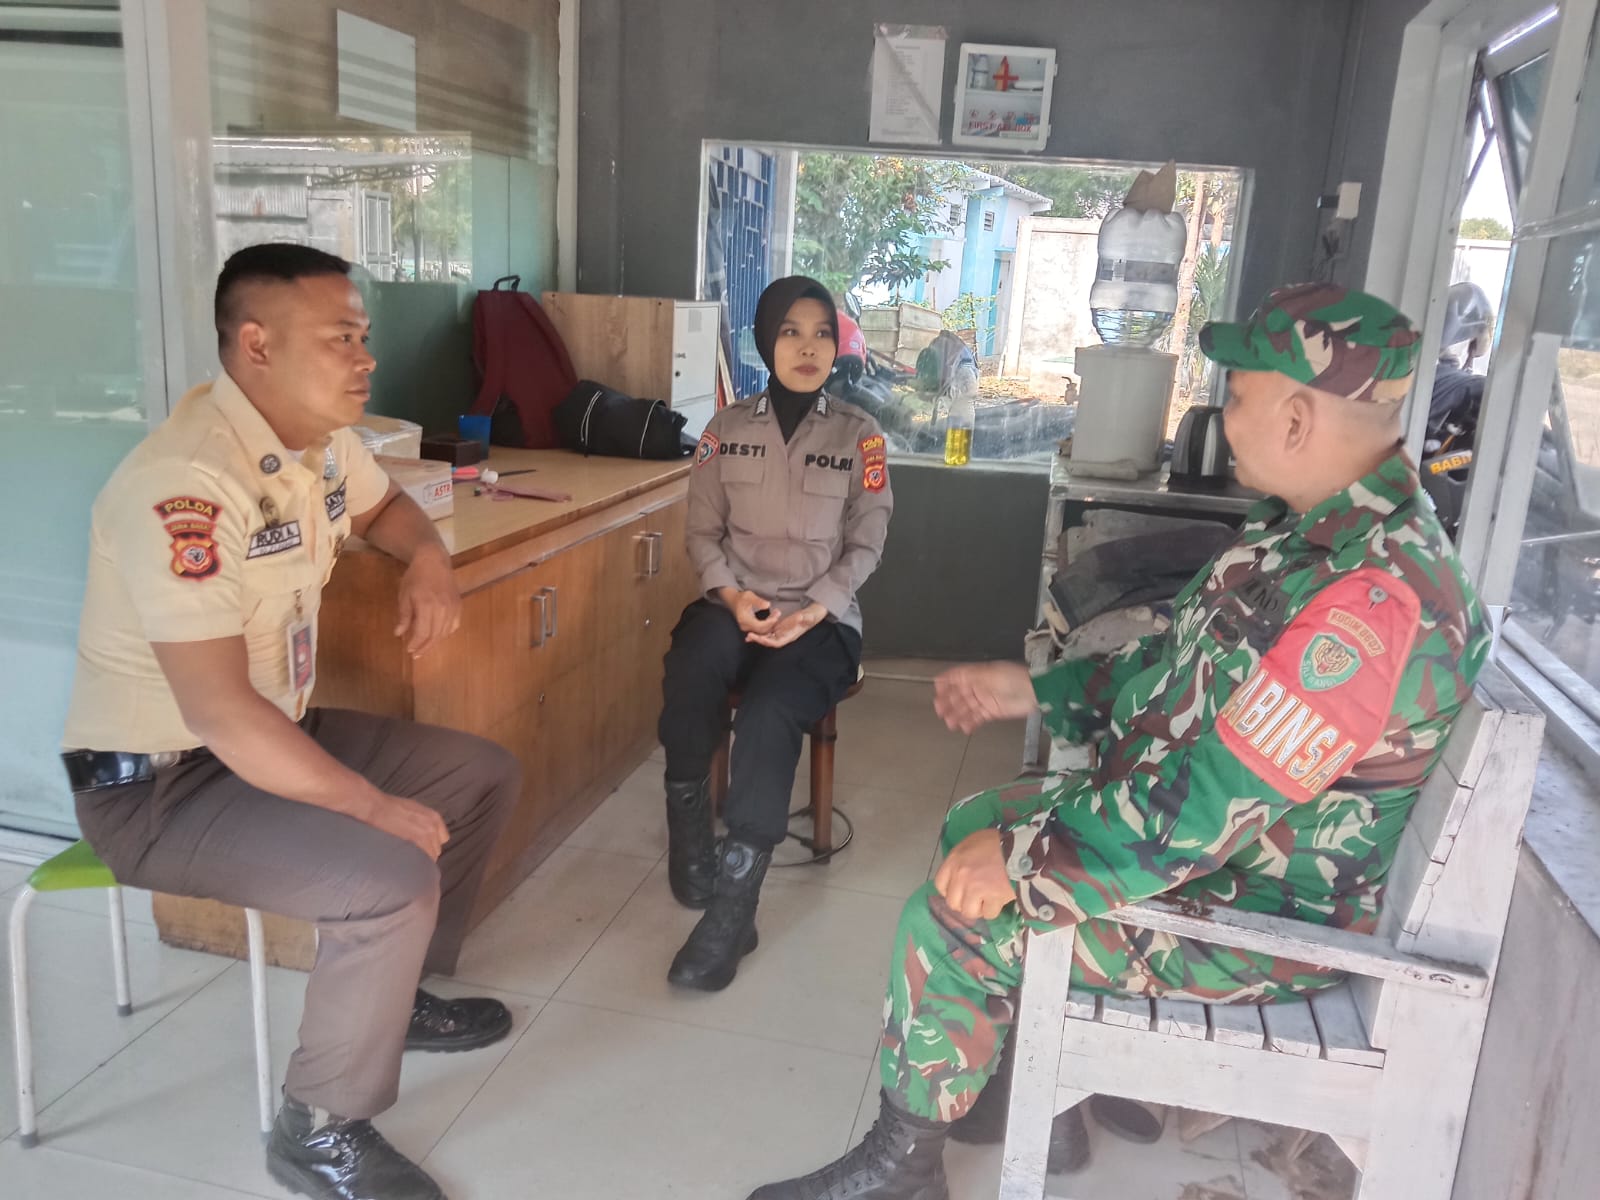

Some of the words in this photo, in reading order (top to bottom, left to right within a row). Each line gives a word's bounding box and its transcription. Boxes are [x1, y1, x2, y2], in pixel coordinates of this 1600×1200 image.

[719, 442, 766, 458] DESTI
[804, 453, 854, 472] POLRI
[164, 499, 213, 517] POLDA
